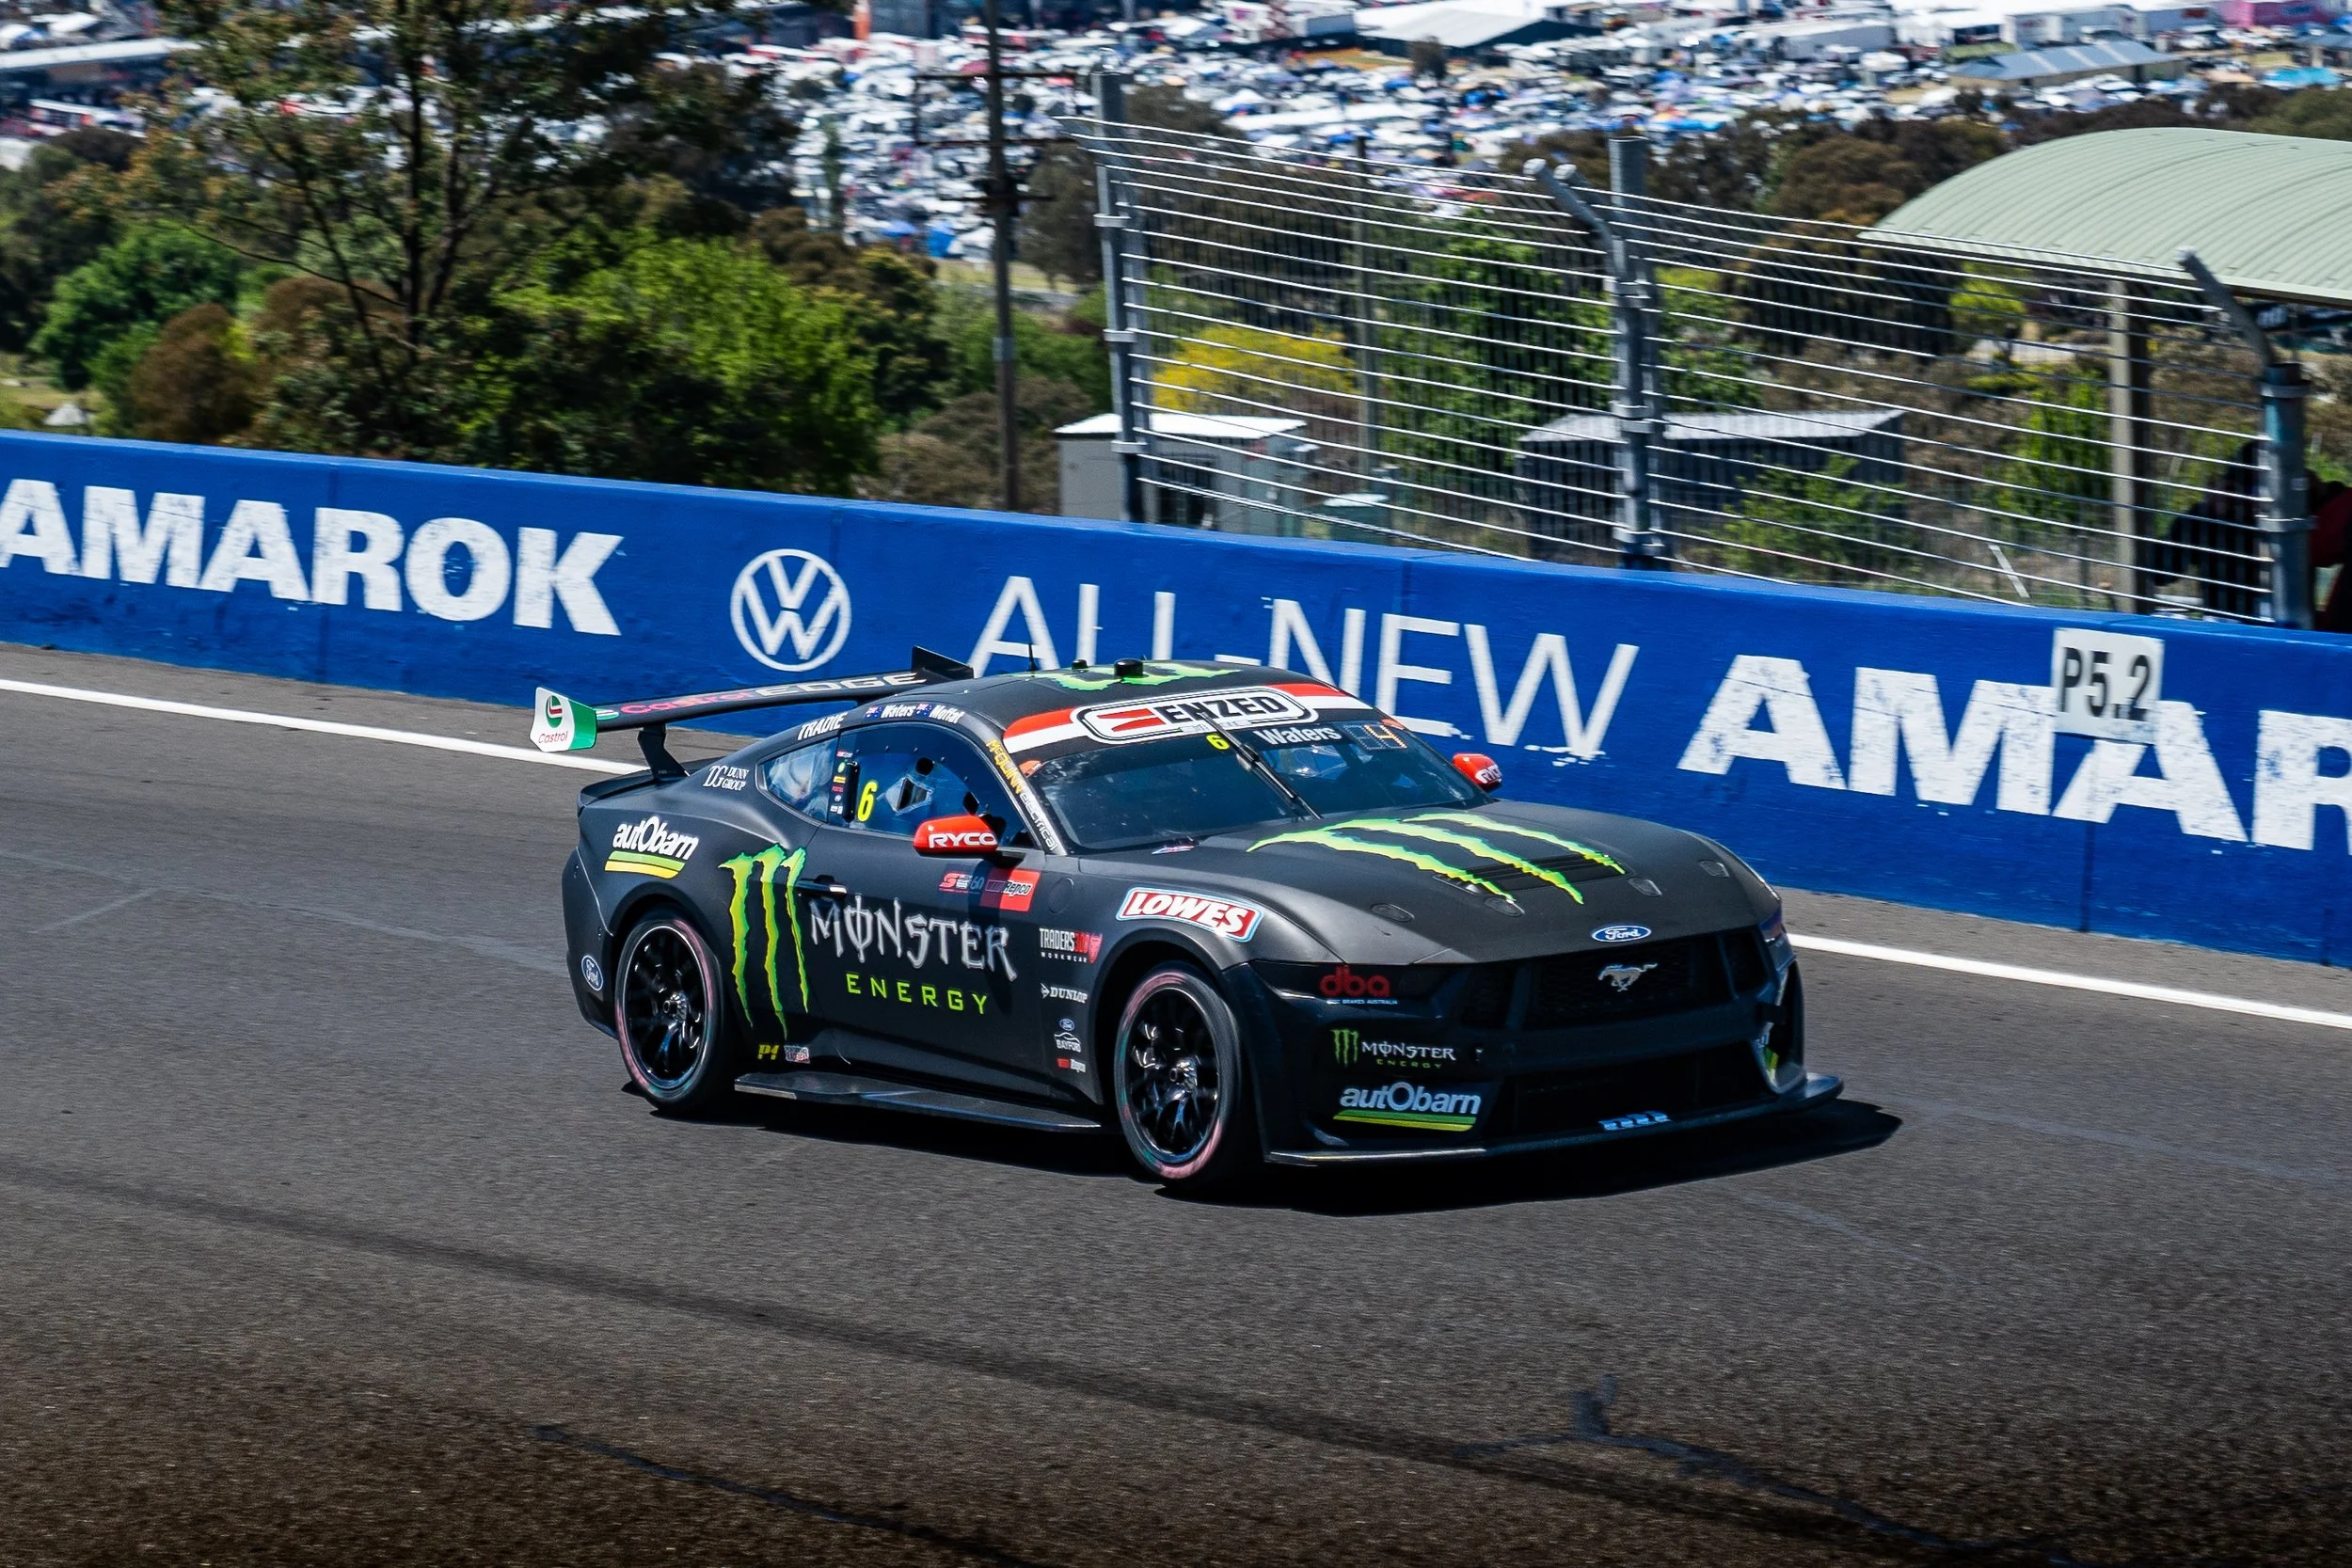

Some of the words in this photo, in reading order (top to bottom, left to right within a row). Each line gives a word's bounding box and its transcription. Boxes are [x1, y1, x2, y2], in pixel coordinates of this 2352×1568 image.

[0, 478, 624, 637] AMAROK
[621, 690, 753, 715] Castrol
[755, 673, 927, 697] EDGE
[2060, 647, 2151, 721] P5.2
[881, 704, 916, 719] Waters
[929, 704, 965, 724] Moffat
[1158, 696, 1290, 724] ENZED
[538, 730, 568, 744] Castrol
[797, 711, 848, 741] TRADIE
[1254, 723, 1343, 746] Waters
[1205, 734, 1231, 751] 6
[726, 767, 750, 779] DUNN
[721, 778, 747, 792] GROUP
[857, 780, 878, 822] 6
[928, 832, 998, 849] RYCO
[1003, 880, 1033, 895] Repco
[1125, 893, 1246, 934] LOWES
[807, 894, 1018, 982] MONSTER
[1040, 927, 1075, 953] TRADERS
[1603, 926, 1641, 940] Ford
[1320, 966, 1390, 997] dba
[846, 973, 987, 1015] ENERGY
[1049, 986, 1089, 1004] DUNLOP
[1362, 1041, 1456, 1061] MONSTER
[1376, 1058, 1442, 1069] ENERGY
